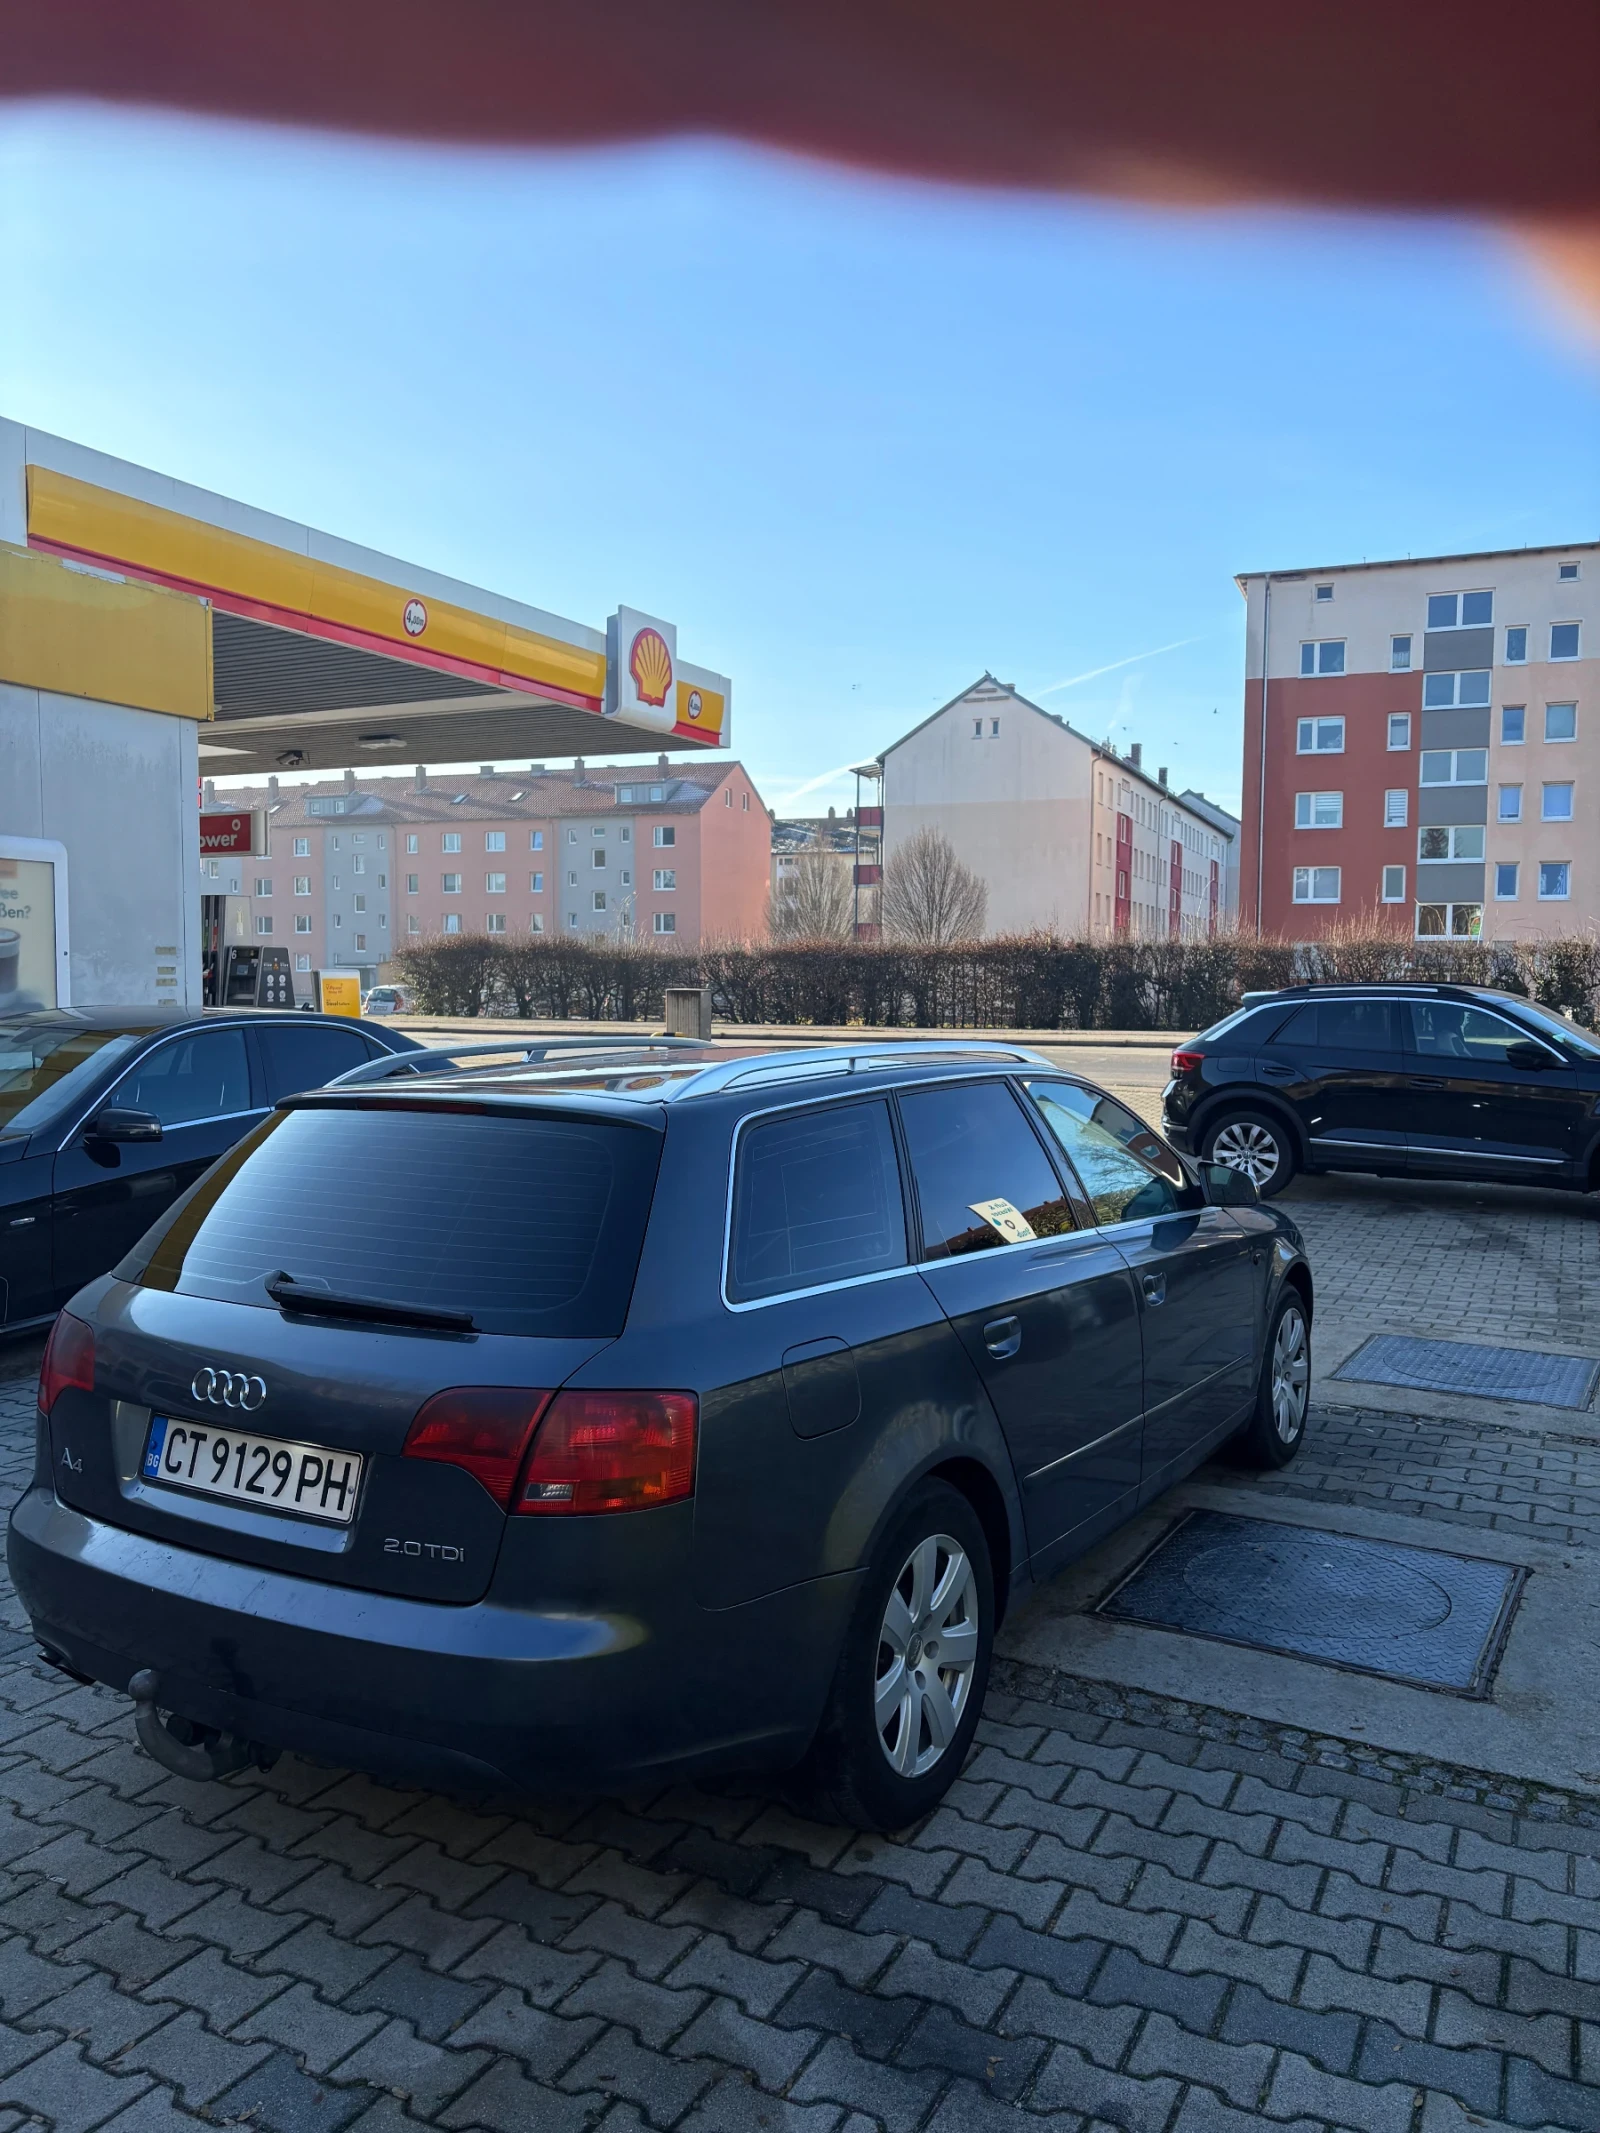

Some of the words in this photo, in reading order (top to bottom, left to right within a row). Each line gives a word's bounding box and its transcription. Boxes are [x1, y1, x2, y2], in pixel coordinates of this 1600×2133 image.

[231, 949, 237, 960] 6
[60, 1447, 83, 1474] A4
[147, 1453, 160, 1468] BG
[383, 1538, 422, 1556] 2.0
